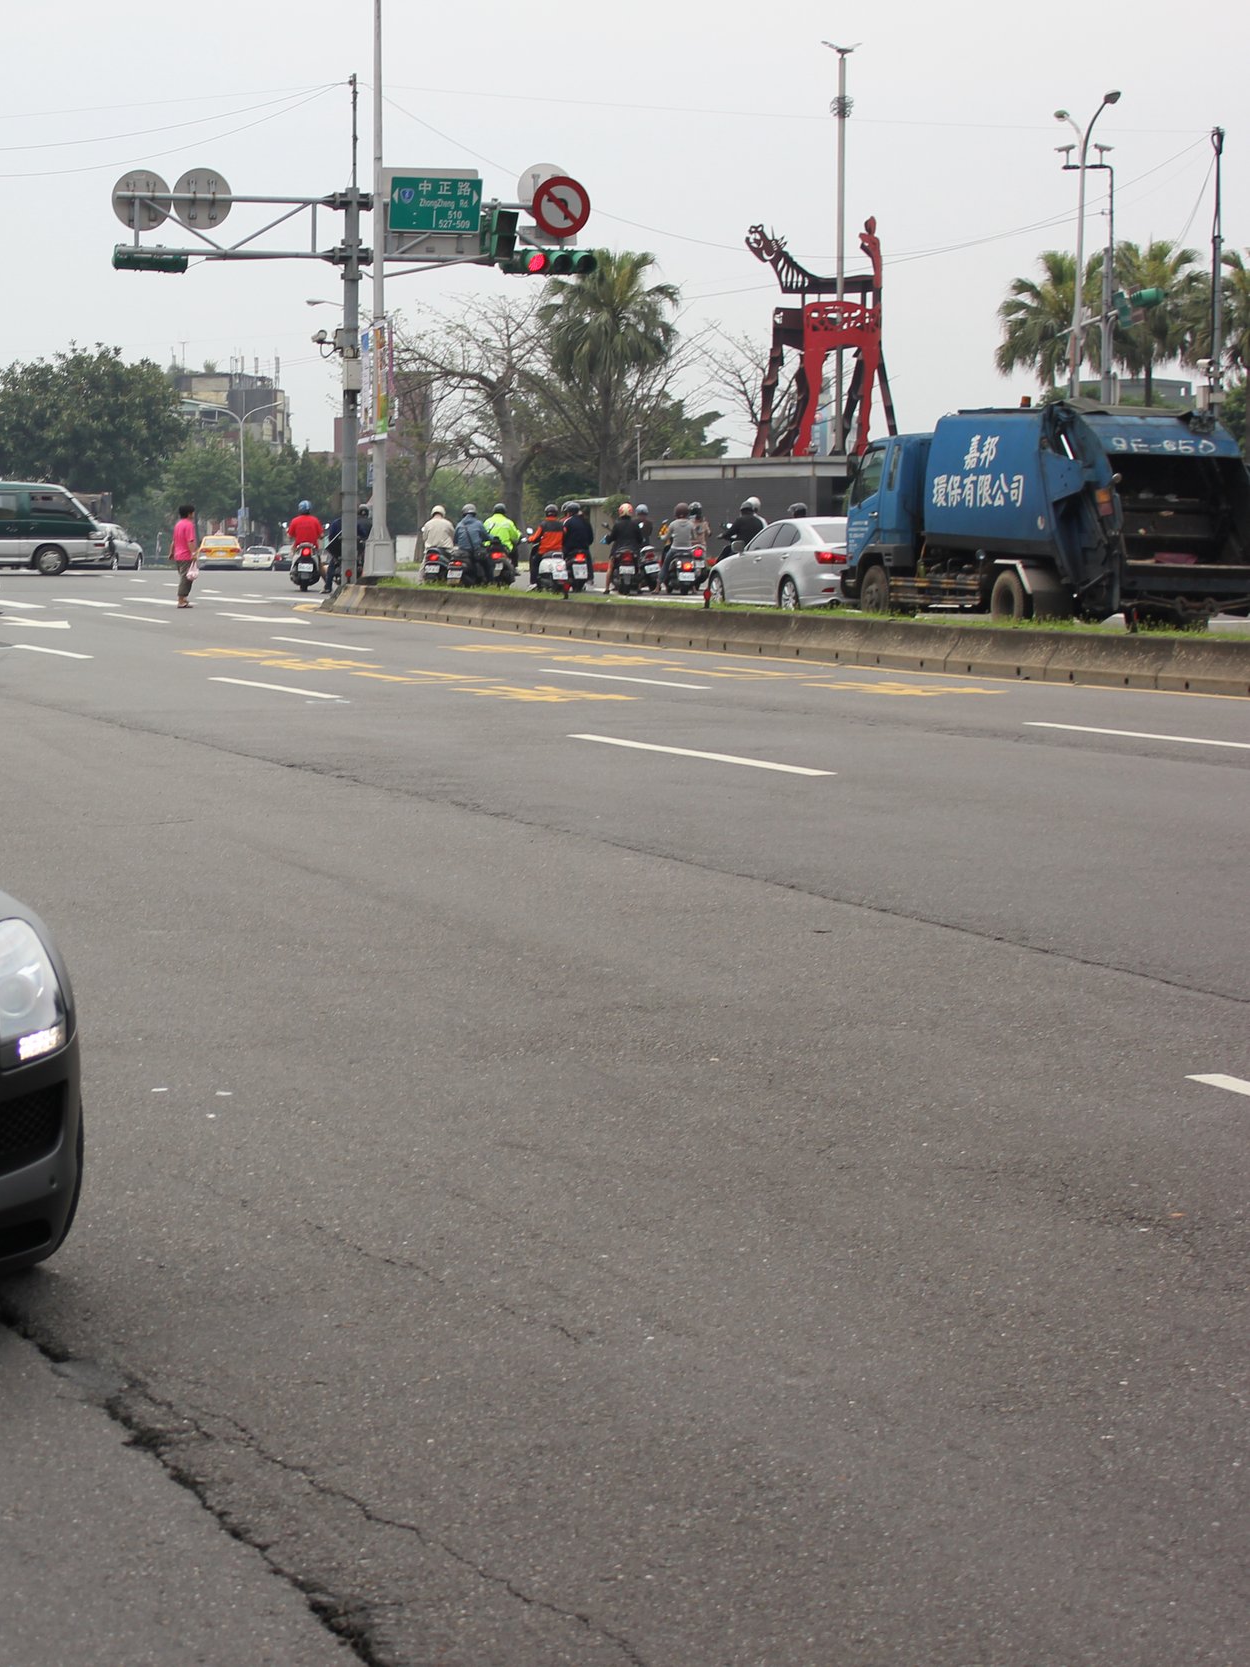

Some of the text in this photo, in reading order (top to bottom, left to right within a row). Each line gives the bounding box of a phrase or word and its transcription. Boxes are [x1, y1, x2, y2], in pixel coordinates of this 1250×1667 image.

[418, 180, 472, 196] 中正路
[447, 210, 462, 219] 510
[438, 219, 471, 229] 527-509
[963, 434, 1000, 470] 嘉邦
[932, 473, 1024, 508] 環保有限公司
